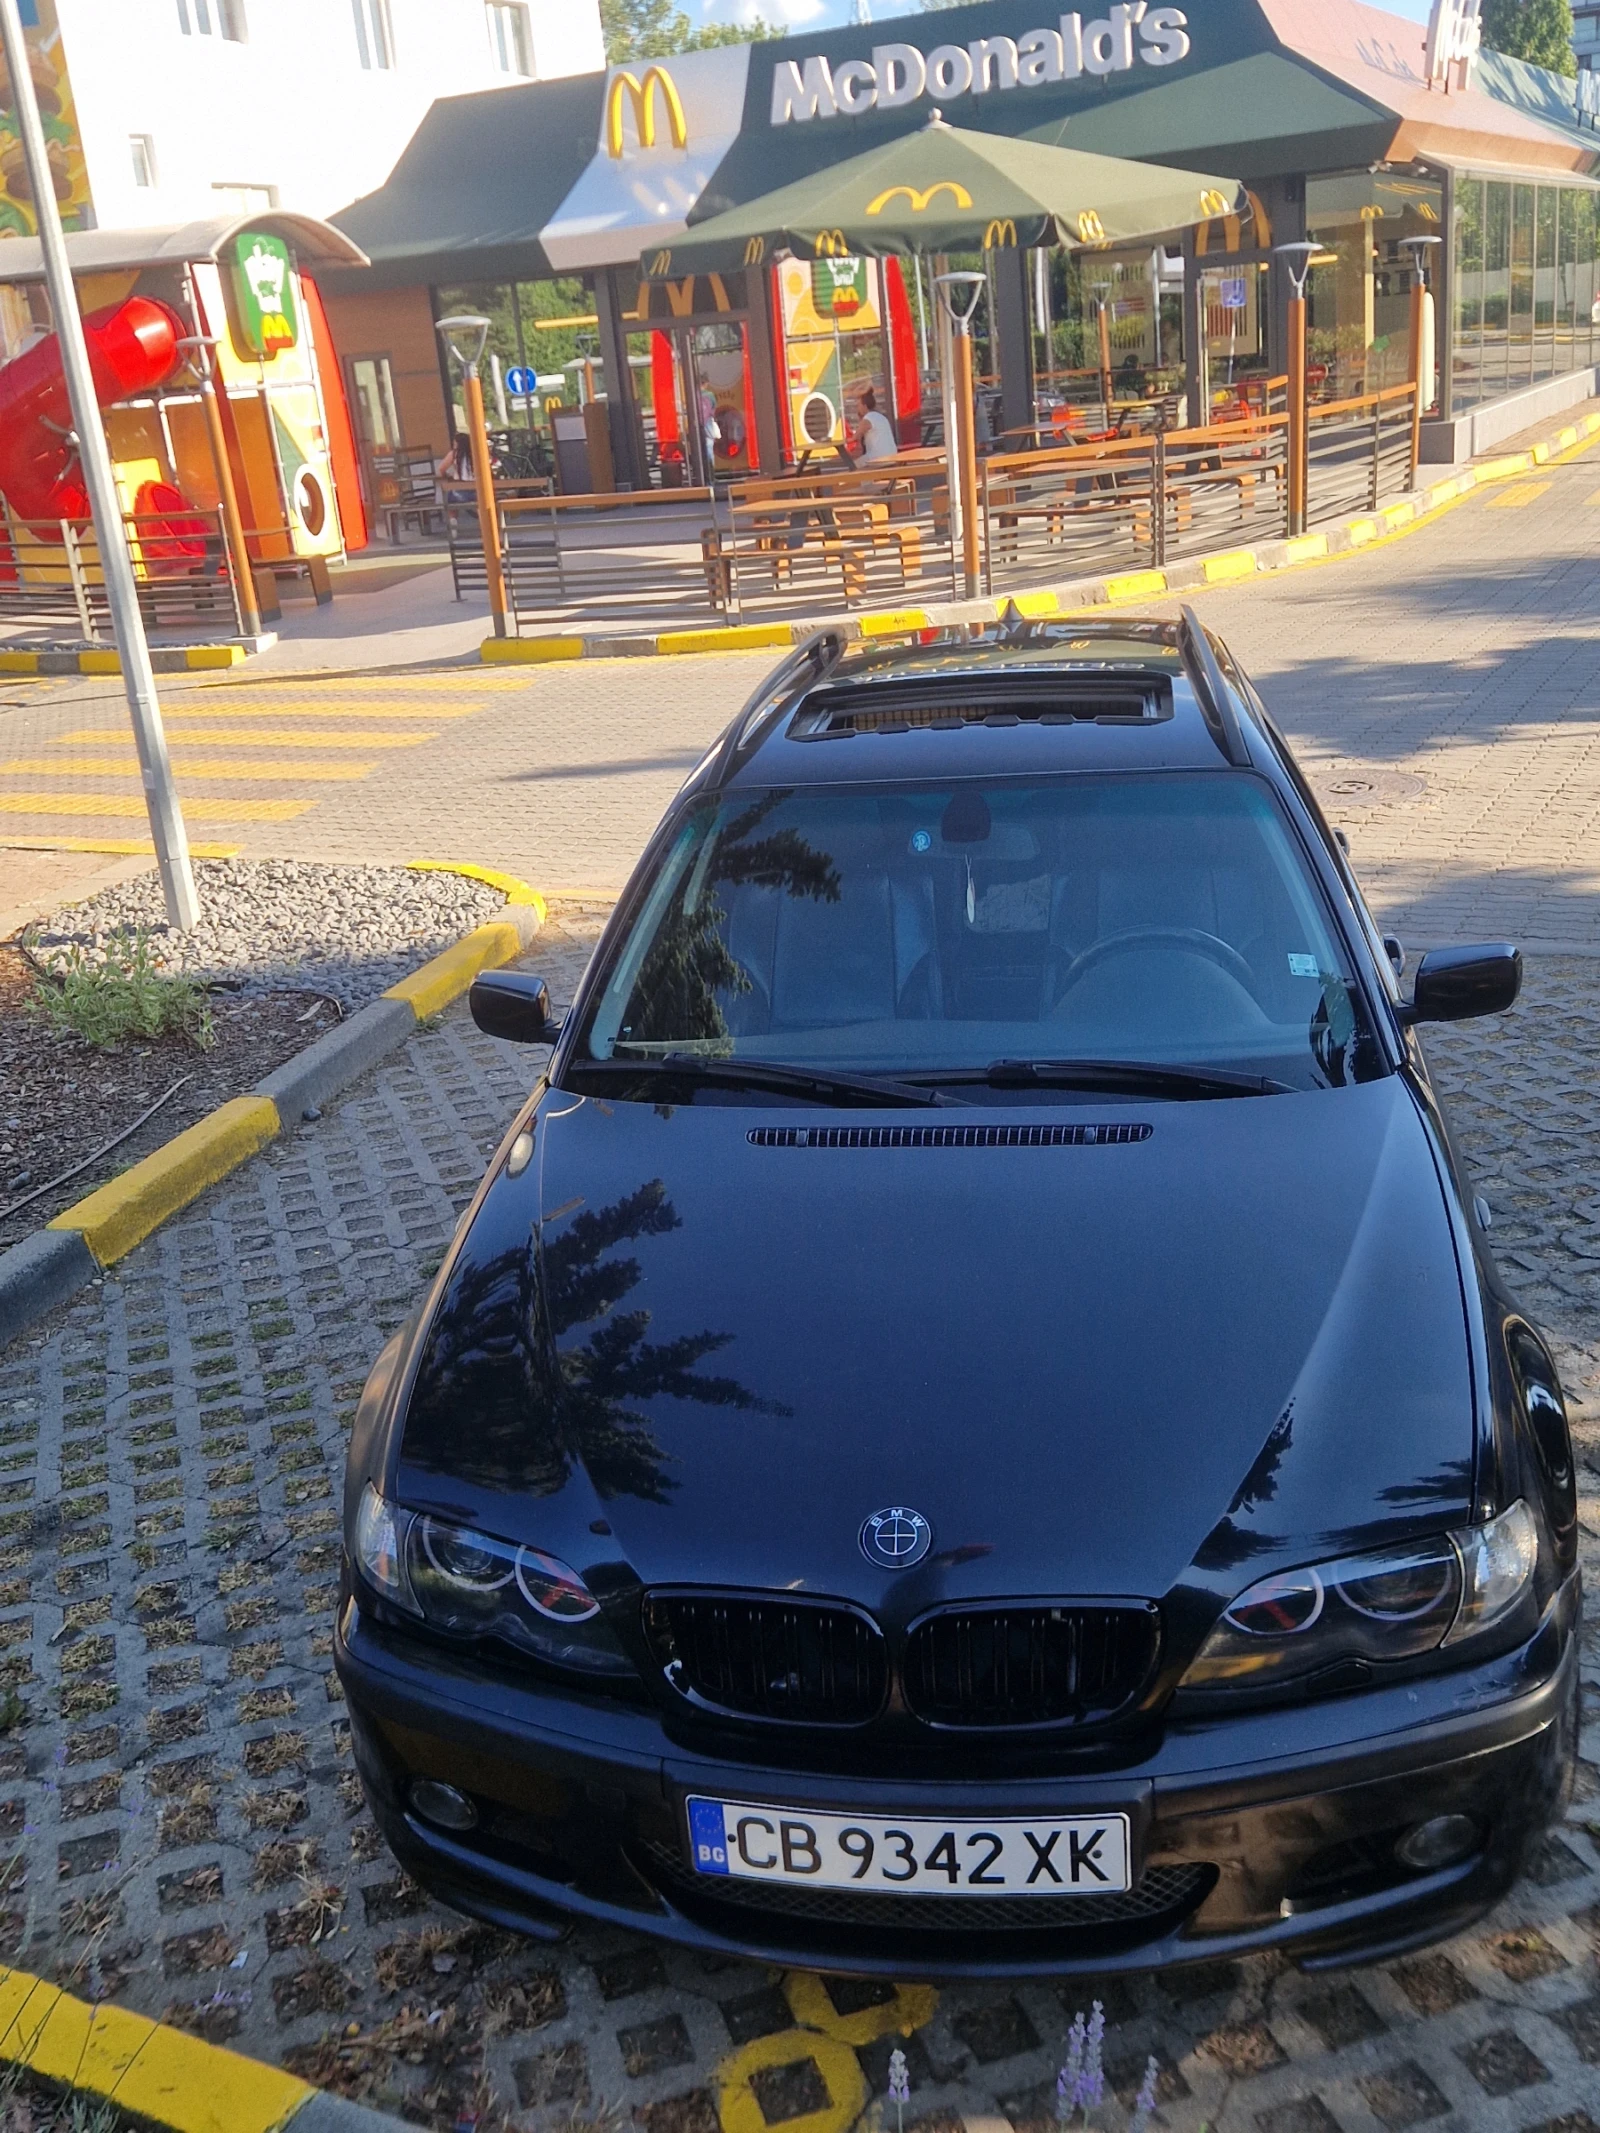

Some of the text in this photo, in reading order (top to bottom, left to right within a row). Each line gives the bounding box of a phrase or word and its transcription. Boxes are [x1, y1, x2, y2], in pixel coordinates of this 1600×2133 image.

[770, 1, 1190, 126] McDonald's
[870, 1509, 925, 1527] BMW
[698, 1844, 725, 1863] BG
[737, 1816, 1110, 1884] CB 9342 XK
